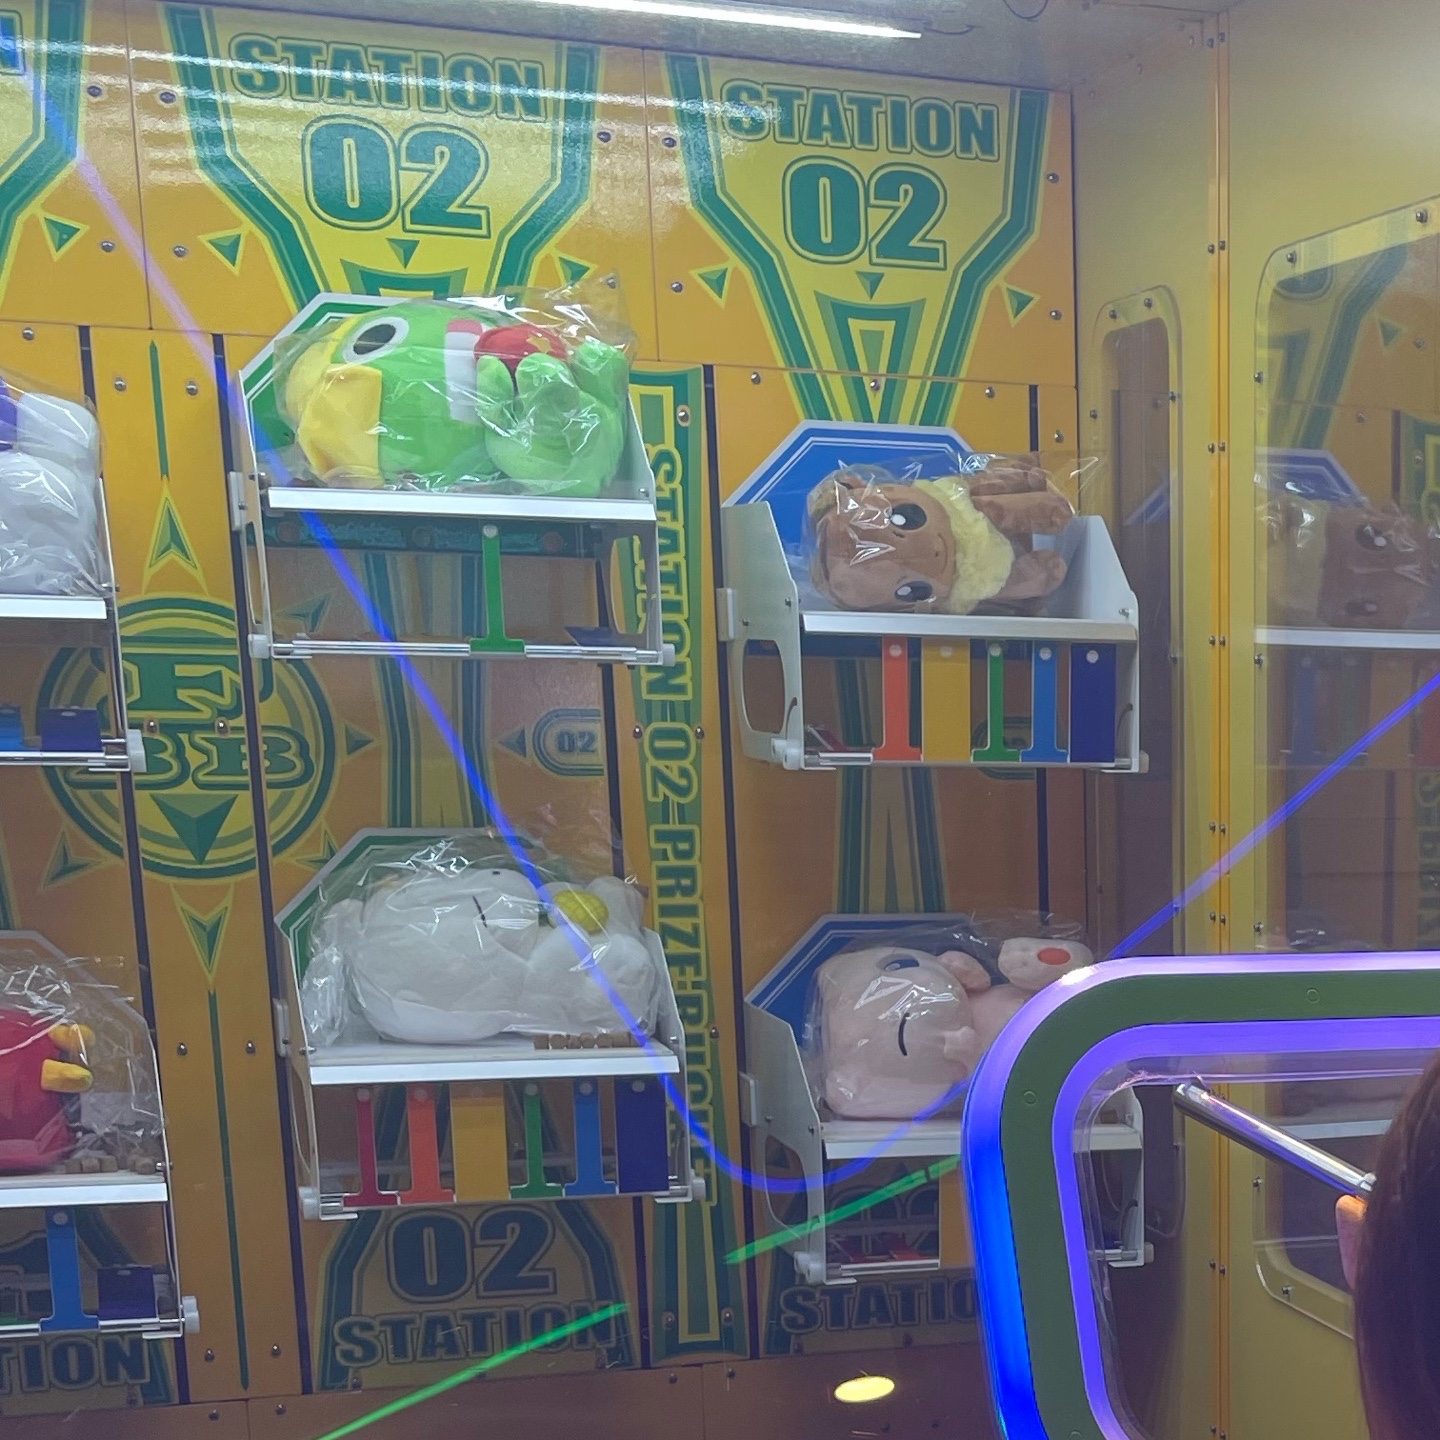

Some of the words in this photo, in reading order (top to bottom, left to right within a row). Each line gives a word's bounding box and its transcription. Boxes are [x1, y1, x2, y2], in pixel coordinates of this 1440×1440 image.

[228, 34, 546, 121] STATION
[720, 79, 999, 161] STATION
[301, 114, 490, 238] 02
[782, 155, 947, 270] 02
[557, 731, 596, 753] 02
[644, 722, 698, 802] 02
[386, 1204, 557, 1303] 02
[333, 1303, 617, 1368] STATION
